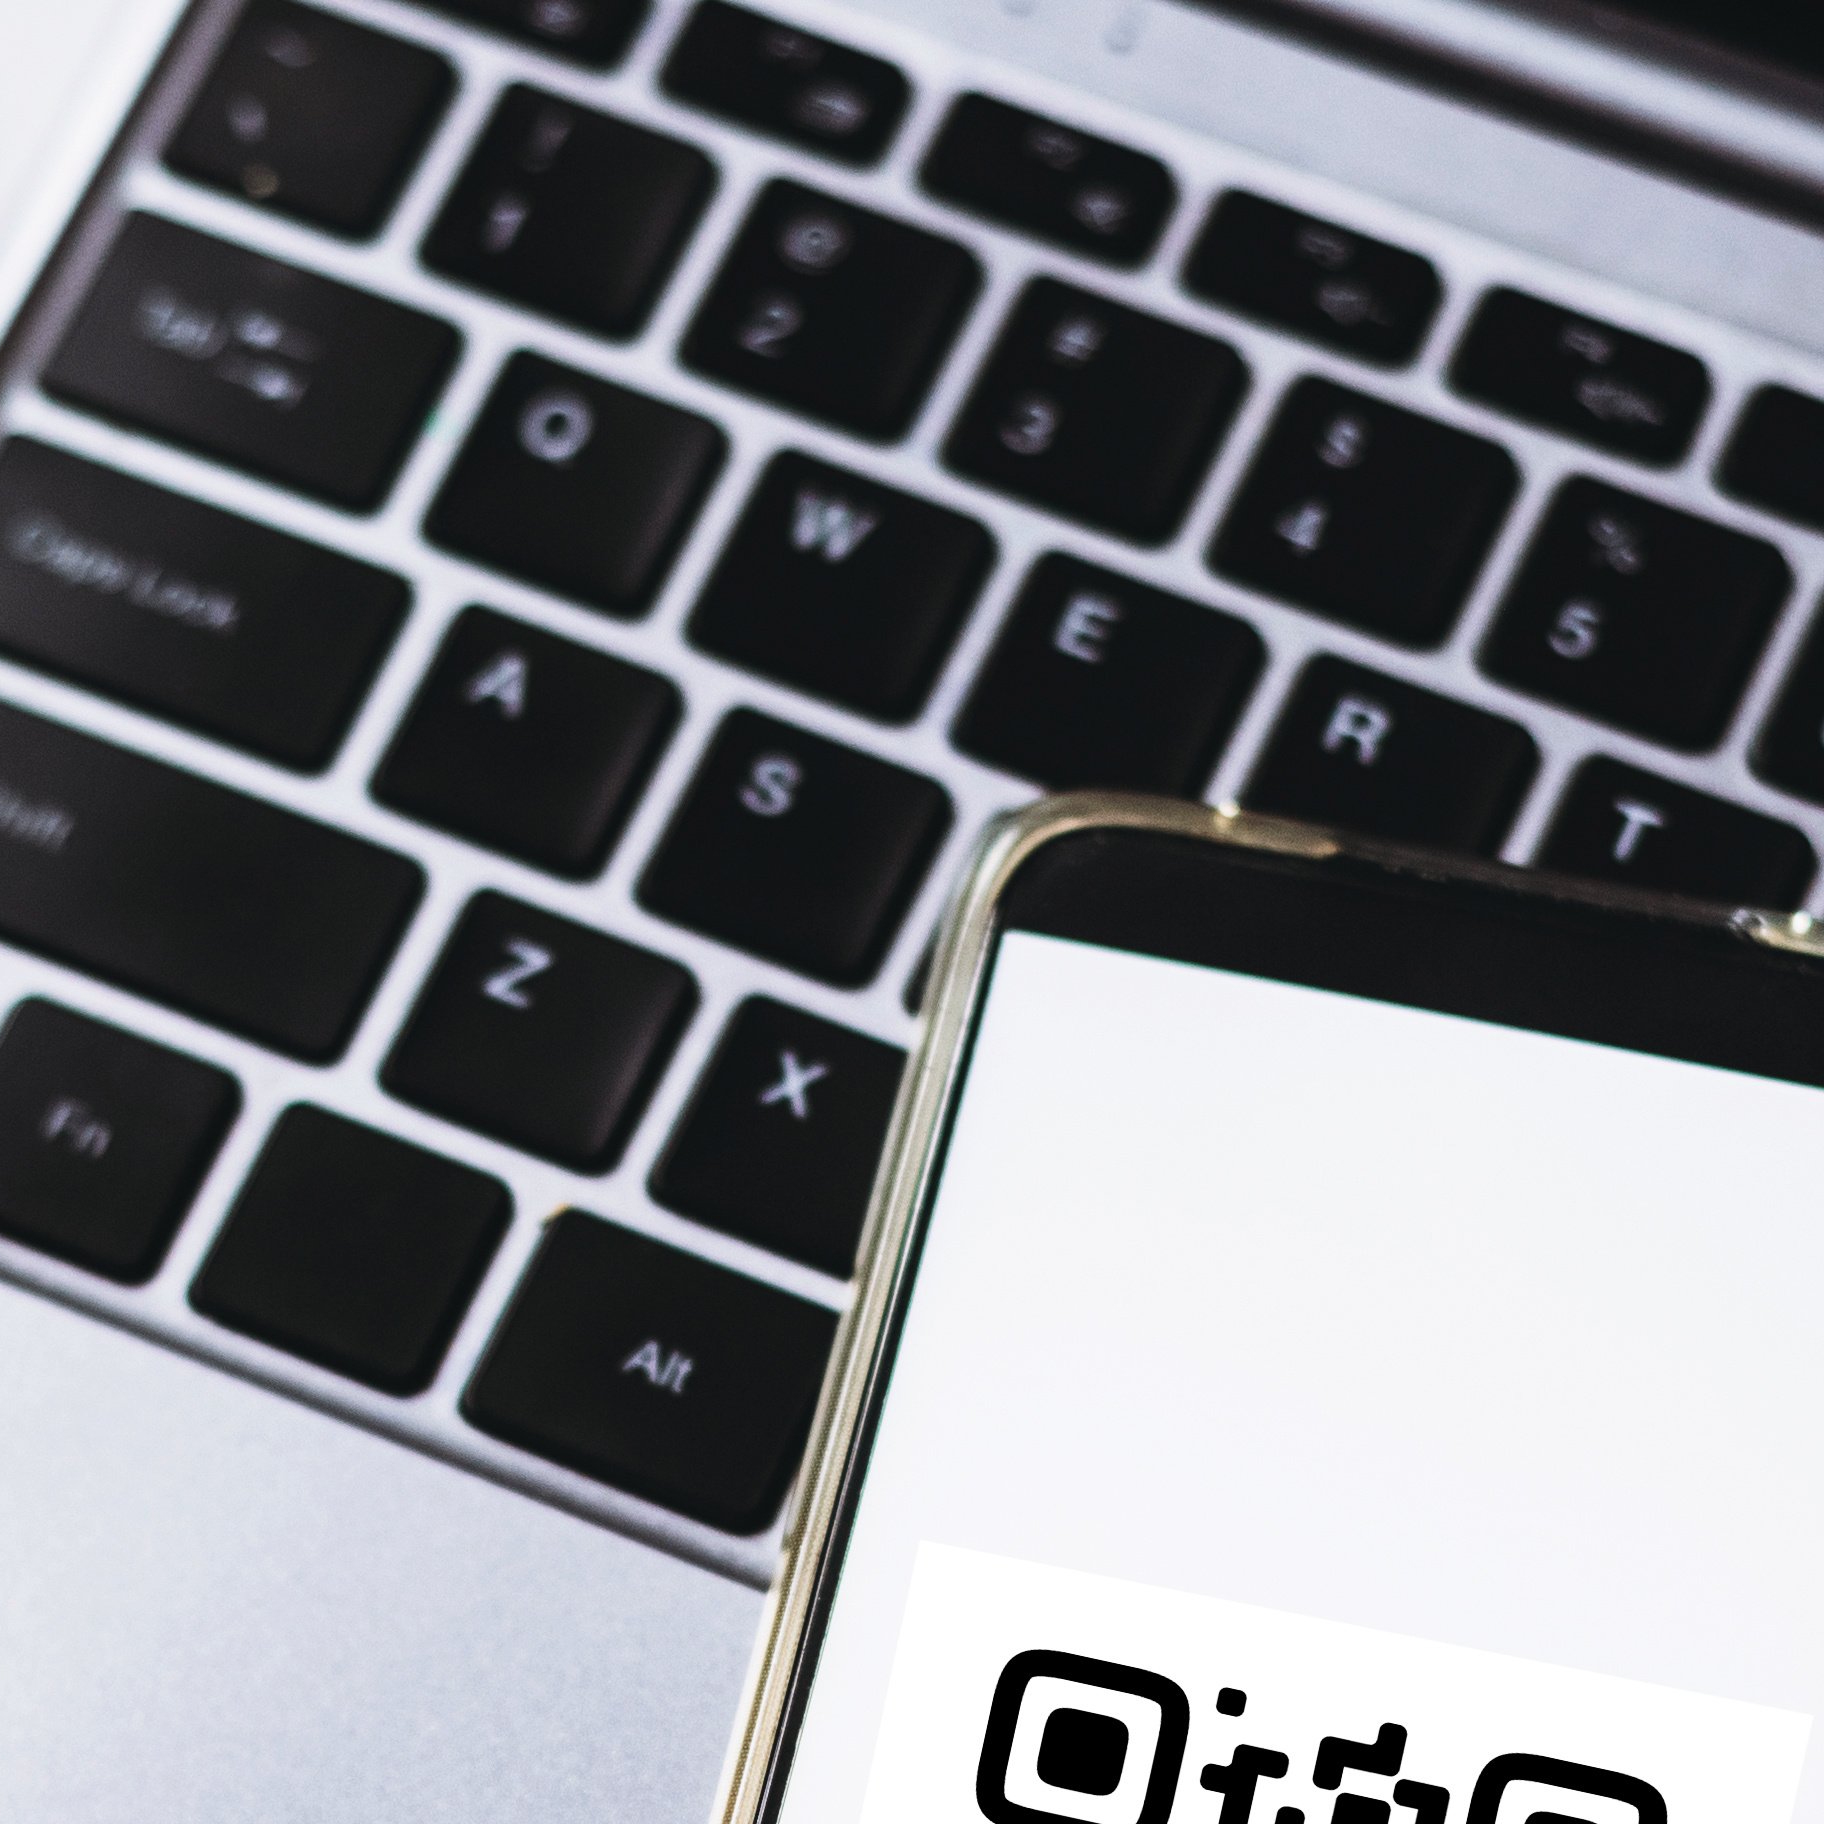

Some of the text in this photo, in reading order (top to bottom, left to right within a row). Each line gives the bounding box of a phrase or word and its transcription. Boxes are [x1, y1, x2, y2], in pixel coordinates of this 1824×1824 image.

[1001, 398, 1057, 455] 3
[786, 486, 882, 566] W
[1054, 593, 1118, 662] E
[1548, 602, 1600, 659] 5
[469, 653, 528, 716] A
[1322, 696, 1391, 764] R
[740, 755, 801, 817] S
[1613, 800, 1664, 862] T
[482, 939, 553, 1008] Z
[761, 1051, 827, 1118] X
[622, 1339, 694, 1394] Alt
